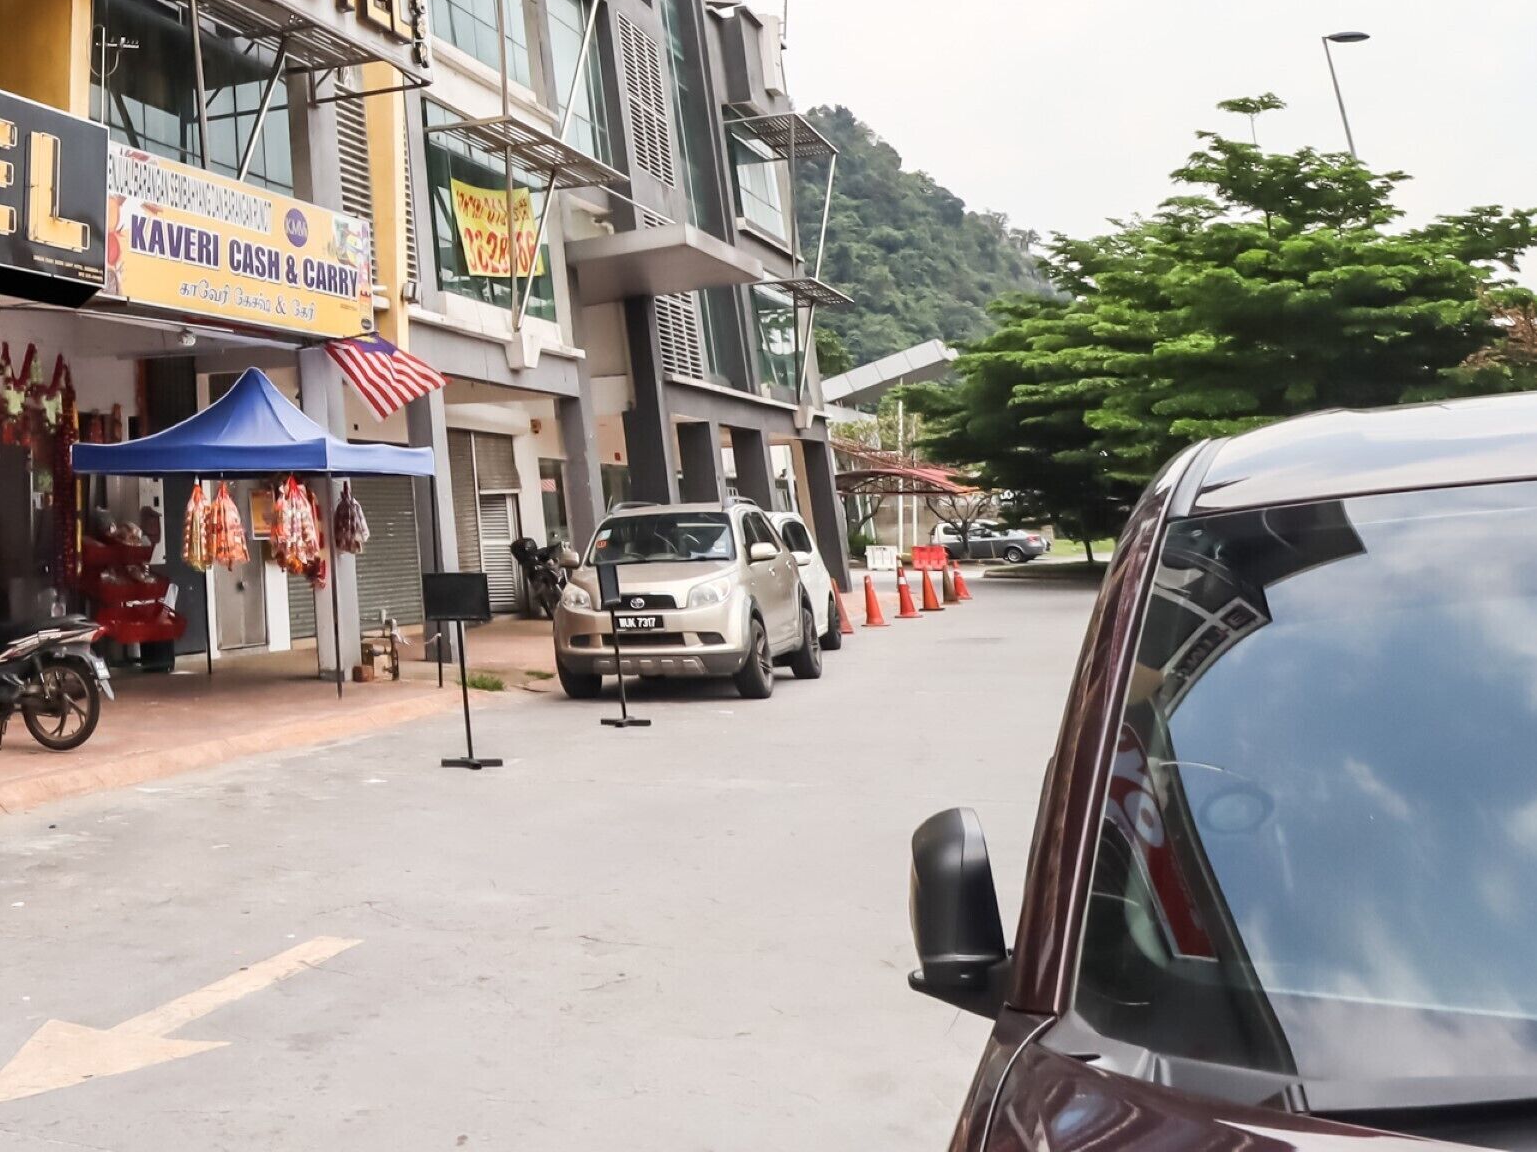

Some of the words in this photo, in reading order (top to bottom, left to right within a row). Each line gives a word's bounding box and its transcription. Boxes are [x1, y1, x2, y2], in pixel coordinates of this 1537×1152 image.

[130, 214, 220, 267] KAVERI
[228, 238, 280, 281] CASH
[285, 255, 299, 285] &
[303, 258, 358, 299] CARRY
